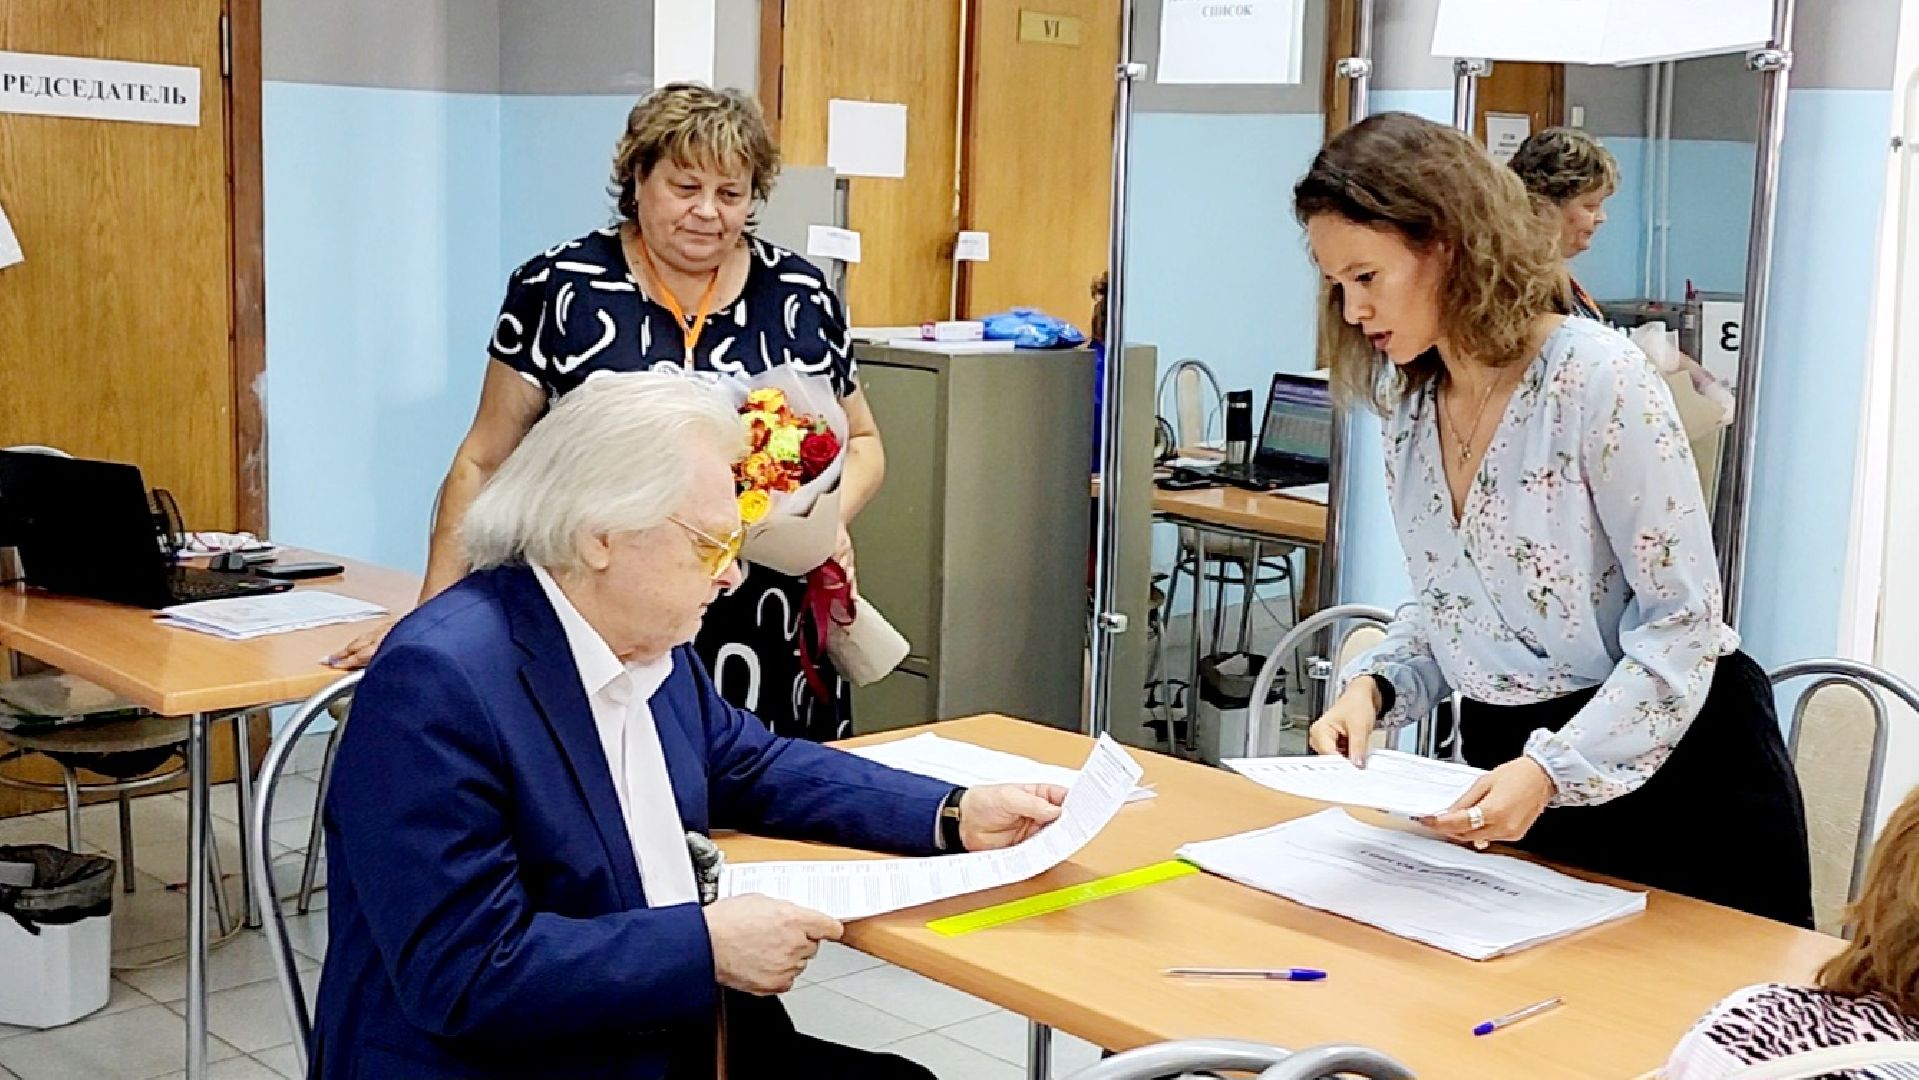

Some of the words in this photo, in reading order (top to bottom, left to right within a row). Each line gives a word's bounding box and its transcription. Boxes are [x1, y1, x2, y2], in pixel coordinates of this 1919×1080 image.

[1201, 4, 1254, 17] СПИСОК
[1043, 19, 1060, 38] VI
[3, 73, 187, 105] РЕДСЕДАТЕЛЬ
